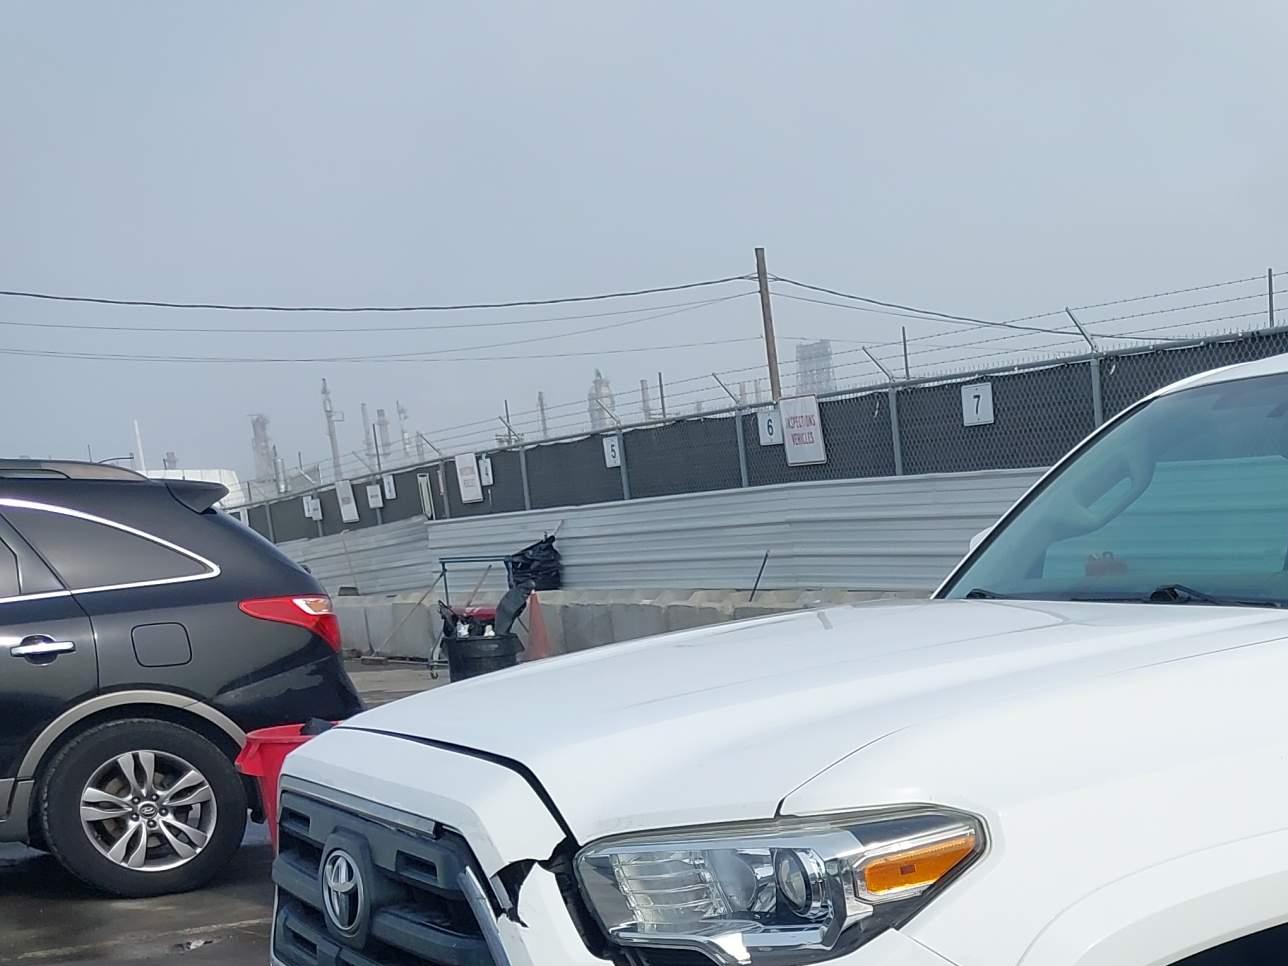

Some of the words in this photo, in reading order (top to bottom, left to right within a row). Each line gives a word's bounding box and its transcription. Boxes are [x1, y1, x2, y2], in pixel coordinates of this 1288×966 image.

[973, 394, 981, 415] 7
[767, 418, 774, 436] 6
[610, 444, 617, 459] 5
